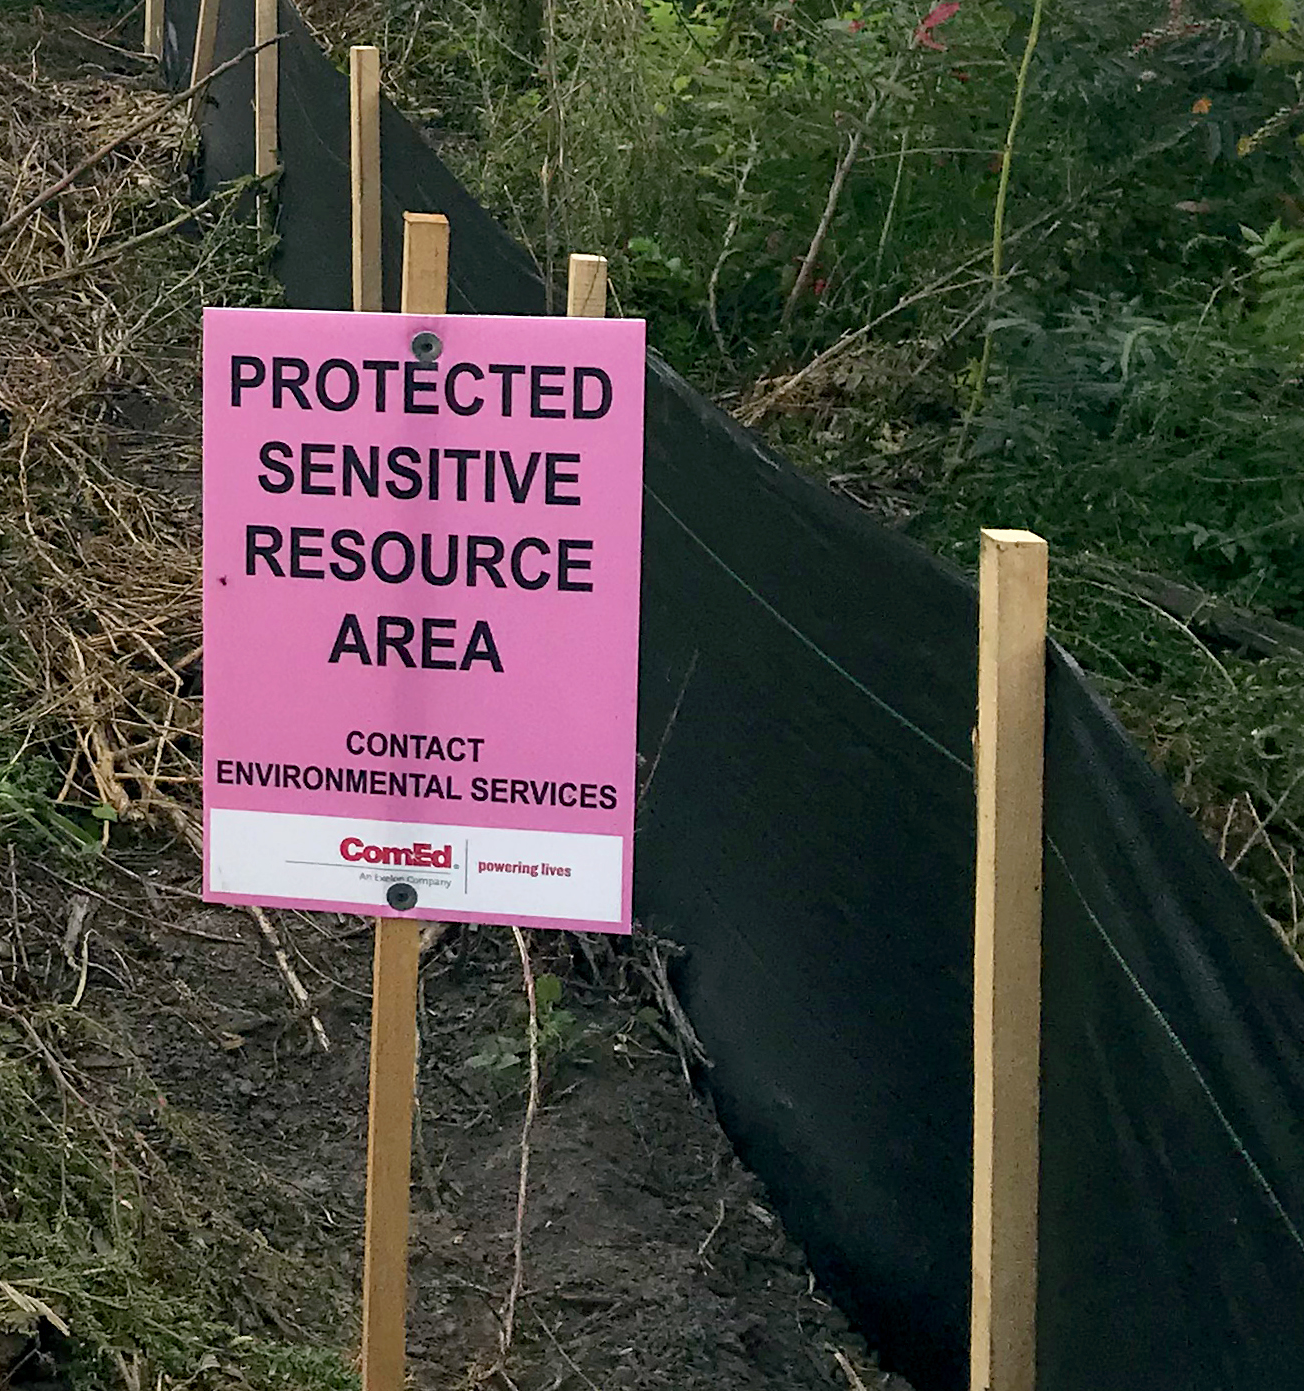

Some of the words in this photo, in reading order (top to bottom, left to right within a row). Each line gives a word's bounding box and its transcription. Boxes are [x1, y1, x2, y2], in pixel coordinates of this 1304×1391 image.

[230, 355, 613, 420] PROTECTED
[257, 441, 582, 506] SENSITIVE
[245, 524, 594, 592] RESOURCE
[328, 613, 504, 673] AREA
[346, 730, 485, 762] CONTACT
[217, 760, 462, 800] ENVIRONMENTAL
[471, 777, 618, 810] SERVICES
[340, 837, 452, 868] ComEd
[478, 860, 539, 877] powering
[541, 863, 572, 878] lives
[406, 875, 452, 889] Company
